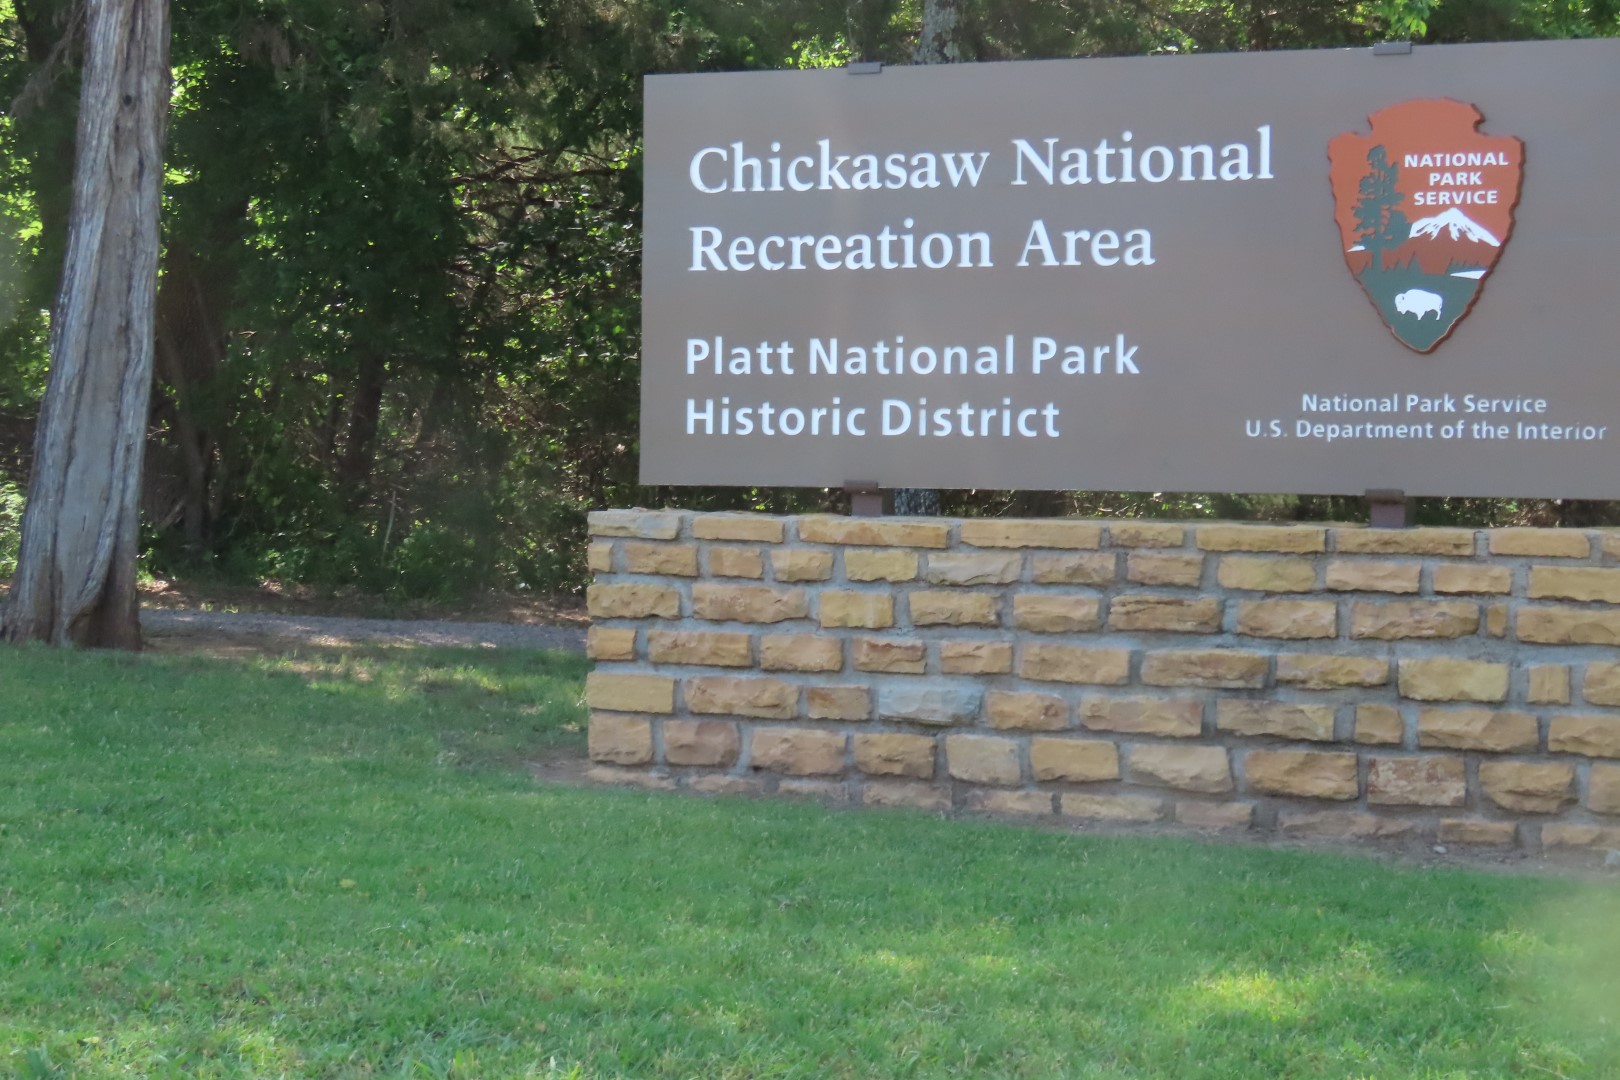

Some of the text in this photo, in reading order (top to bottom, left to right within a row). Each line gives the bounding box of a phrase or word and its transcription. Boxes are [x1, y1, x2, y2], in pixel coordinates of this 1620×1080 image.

[688, 125, 1274, 195] Chickasaw National
[1404, 152, 1509, 168] NATIONAL
[1429, 171, 1483, 187] PARK
[1413, 190, 1499, 206] SERVICE
[688, 218, 1156, 273] Recreation Area
[686, 333, 1140, 377] Platt National Park
[1302, 393, 1547, 413] National Park Service
[686, 396, 1060, 439] Historic District
[1245, 419, 1607, 443] U.S. Department of the Interior
